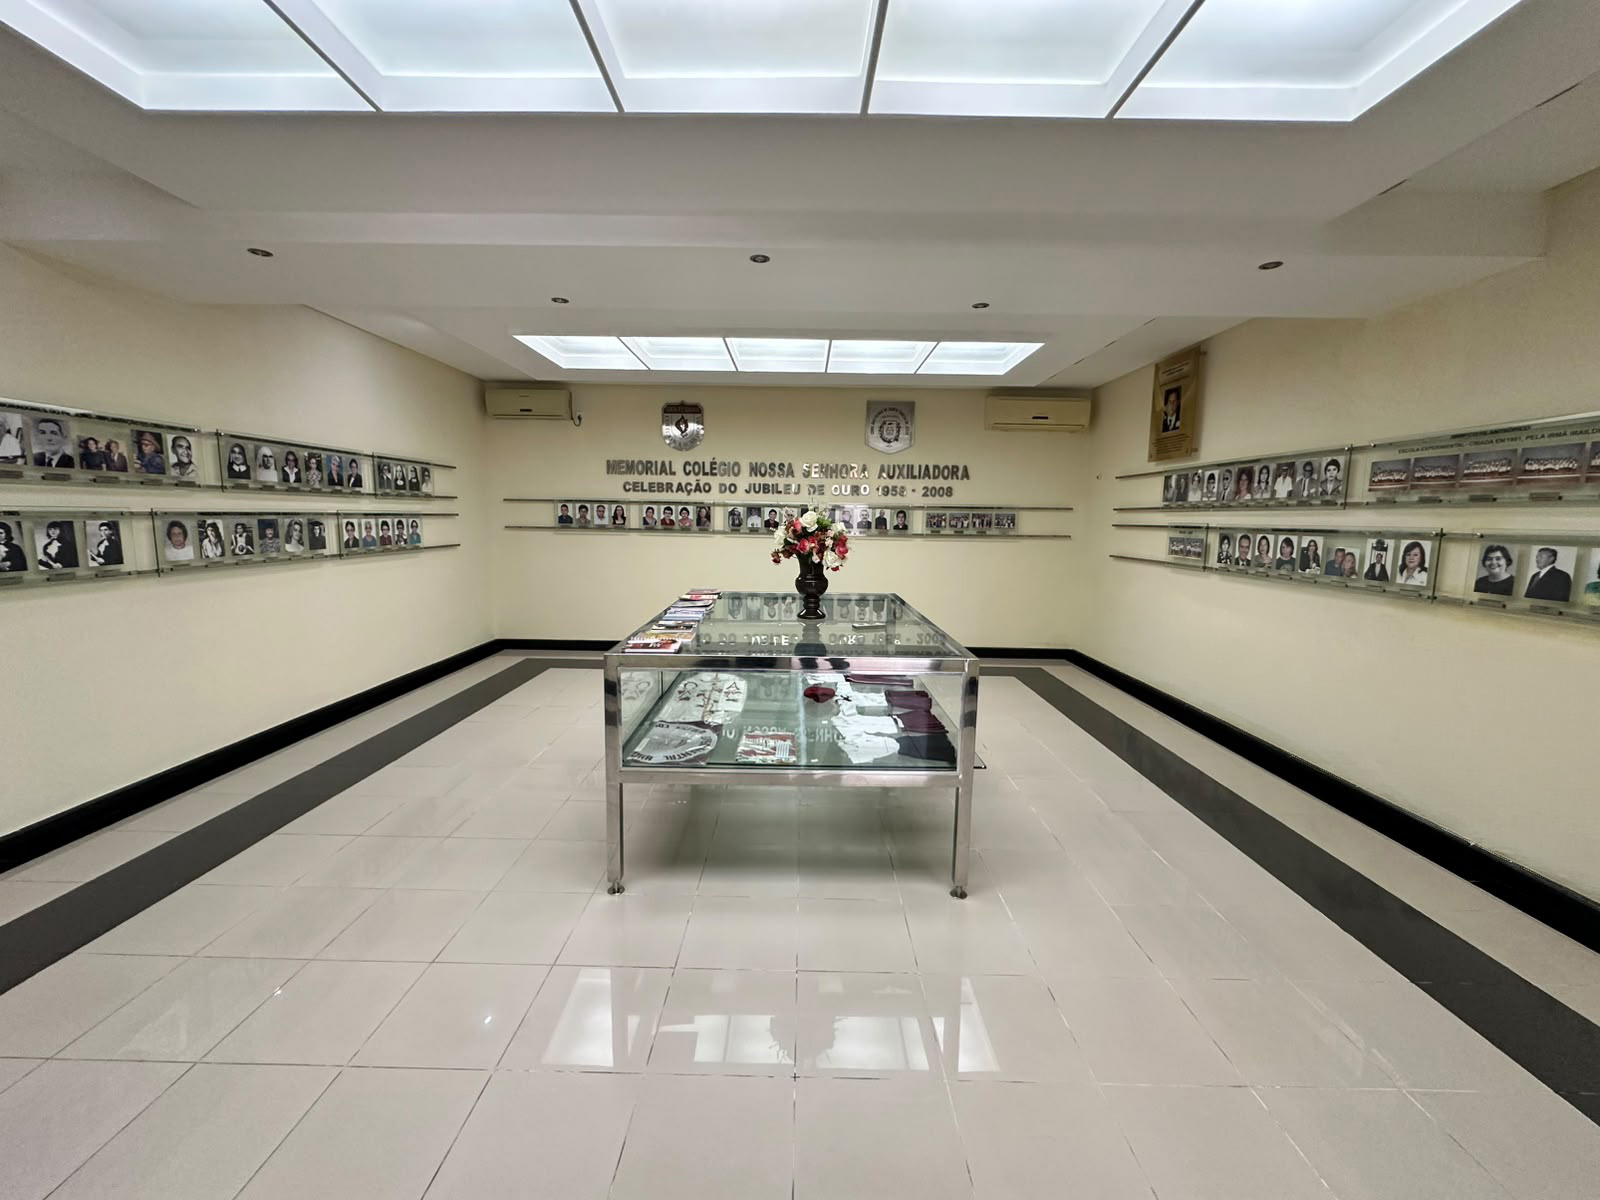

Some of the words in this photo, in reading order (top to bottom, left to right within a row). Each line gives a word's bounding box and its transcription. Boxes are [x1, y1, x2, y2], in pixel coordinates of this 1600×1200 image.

[606, 459, 676, 476] MEMORIAL
[683, 457, 741, 477] COLÉGIO
[749, 461, 795, 478] NOSSA
[802, 463, 869, 479] SENHORA
[877, 464, 970, 480] AUXILIADORA
[623, 479, 712, 496] CELEBRAÇÃO
[718, 483, 738, 494] DO
[745, 483, 801, 495] JUBILEU
[808, 484, 825, 496] DE
[831, 484, 870, 496] OURO
[876, 485, 906, 497] 1958
[922, 486, 953, 498] 2008
